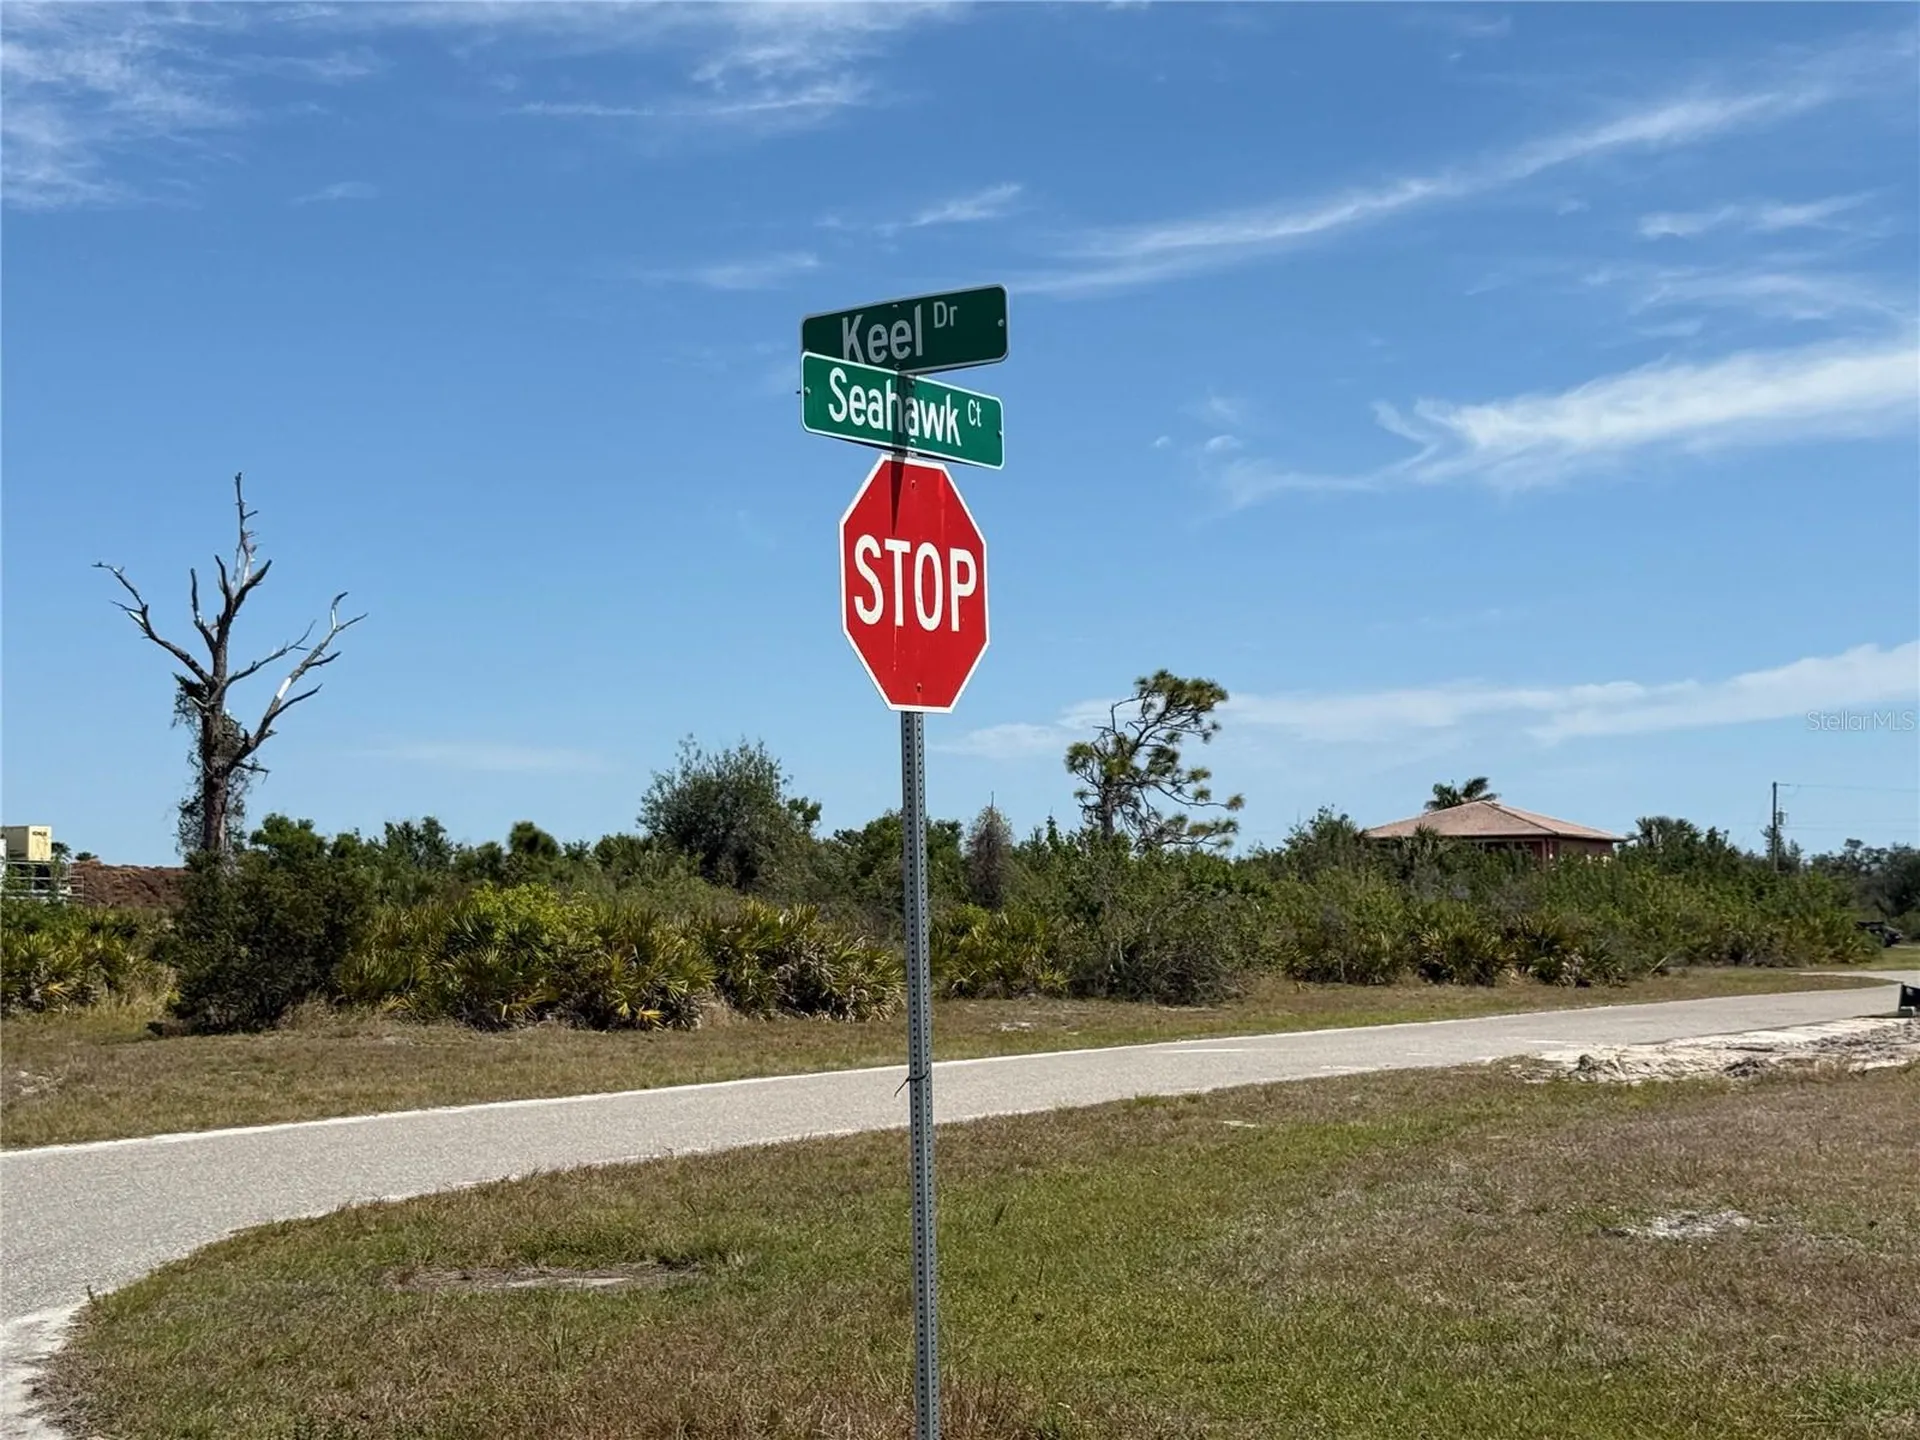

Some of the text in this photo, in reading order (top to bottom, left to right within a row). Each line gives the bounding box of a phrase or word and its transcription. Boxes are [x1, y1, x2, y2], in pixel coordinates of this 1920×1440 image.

[842, 301, 958, 364] Keel Dr
[828, 367, 982, 446] Seahawk Ct
[854, 534, 977, 632] STOP
